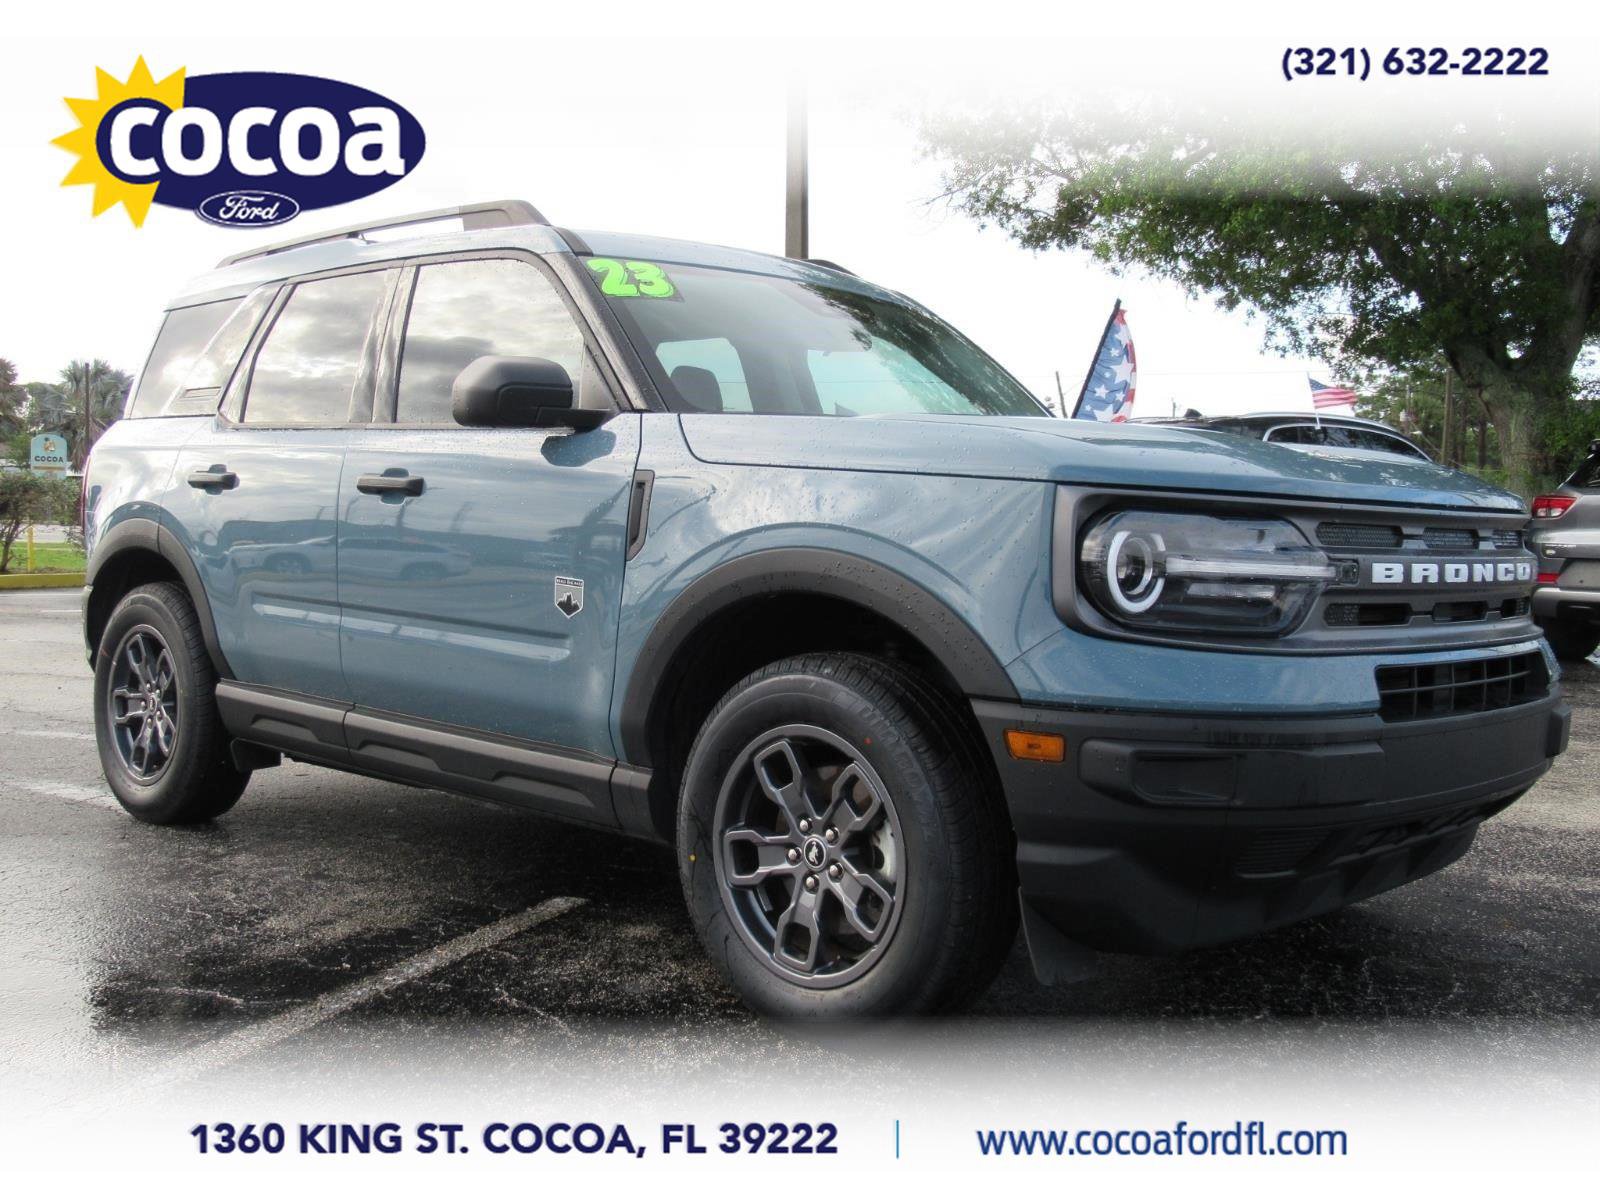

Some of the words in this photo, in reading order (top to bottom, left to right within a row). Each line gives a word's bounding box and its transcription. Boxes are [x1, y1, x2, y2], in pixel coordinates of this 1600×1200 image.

[586, 258, 674, 298] 23
[34, 455, 64, 463] COCOA
[1371, 563, 1531, 583] BRONCO
